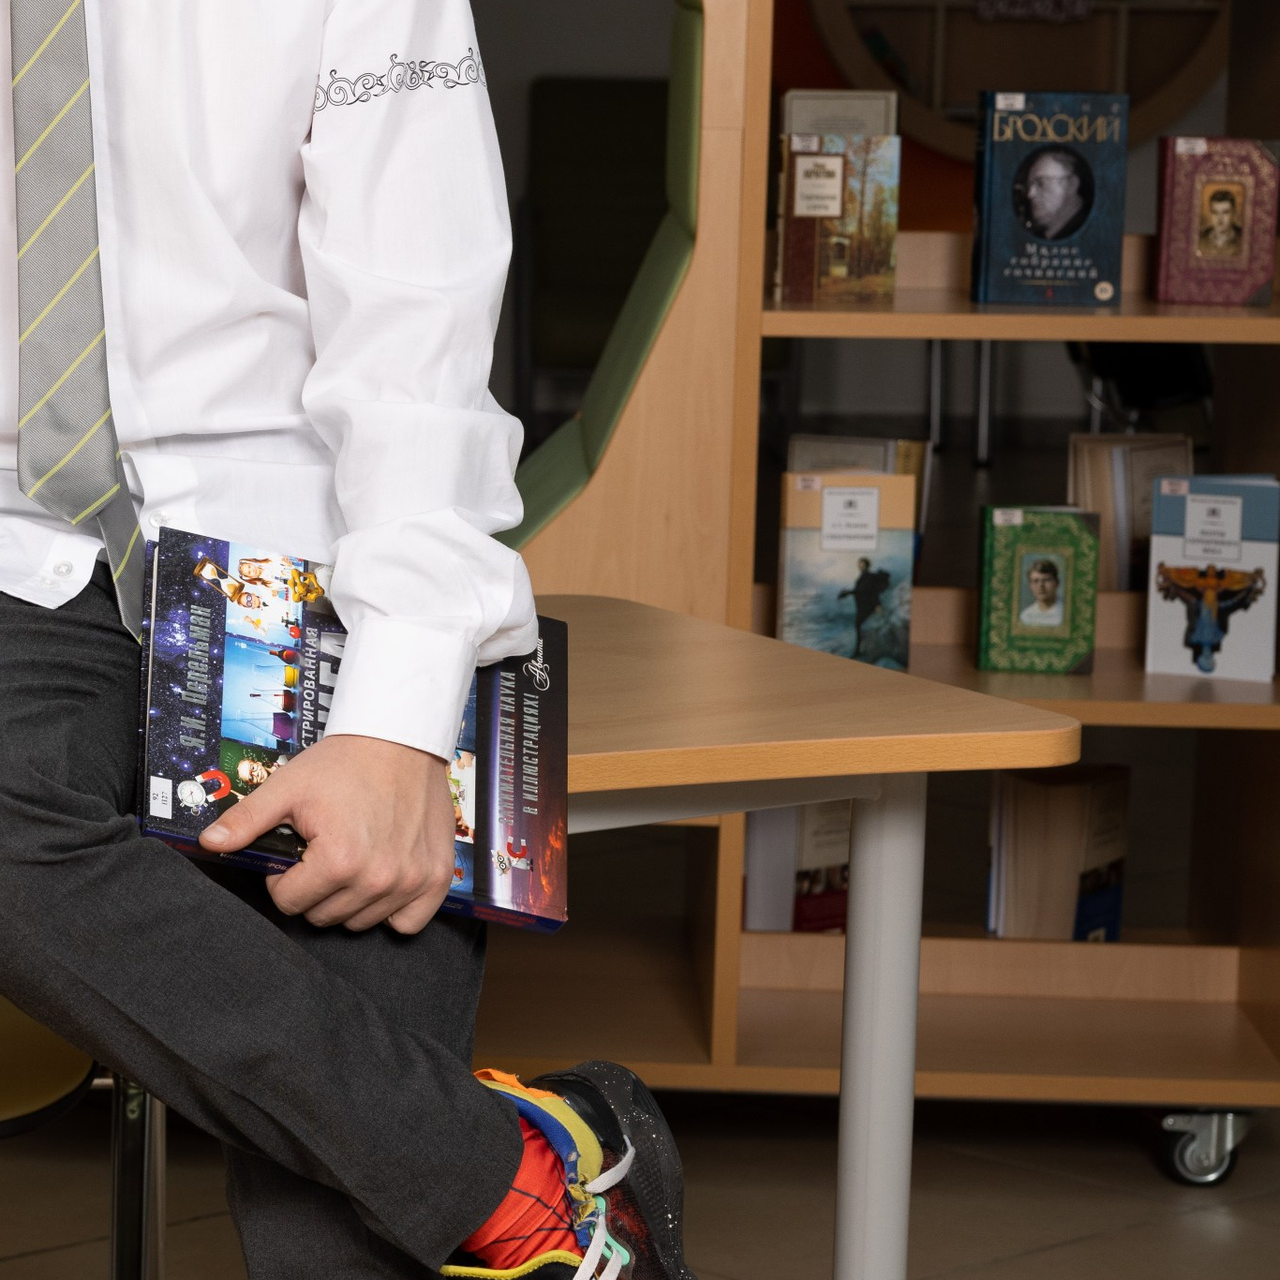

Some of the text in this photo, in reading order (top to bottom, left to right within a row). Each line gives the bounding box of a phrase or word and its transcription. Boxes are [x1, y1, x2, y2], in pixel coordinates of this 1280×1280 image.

[993, 111, 1120, 143] БРОДСКИЙ
[181, 604, 212, 706] Перельман
[301, 626, 319, 750] СТРИРОВАННАЯ
[152, 792, 159, 801] 92
[497, 670, 516, 826] ЗАНИМАТЕЛЬНАЯ НАУКА
[522, 693, 542, 815] В ИЛЛЮСТРАЦИЯХ!
